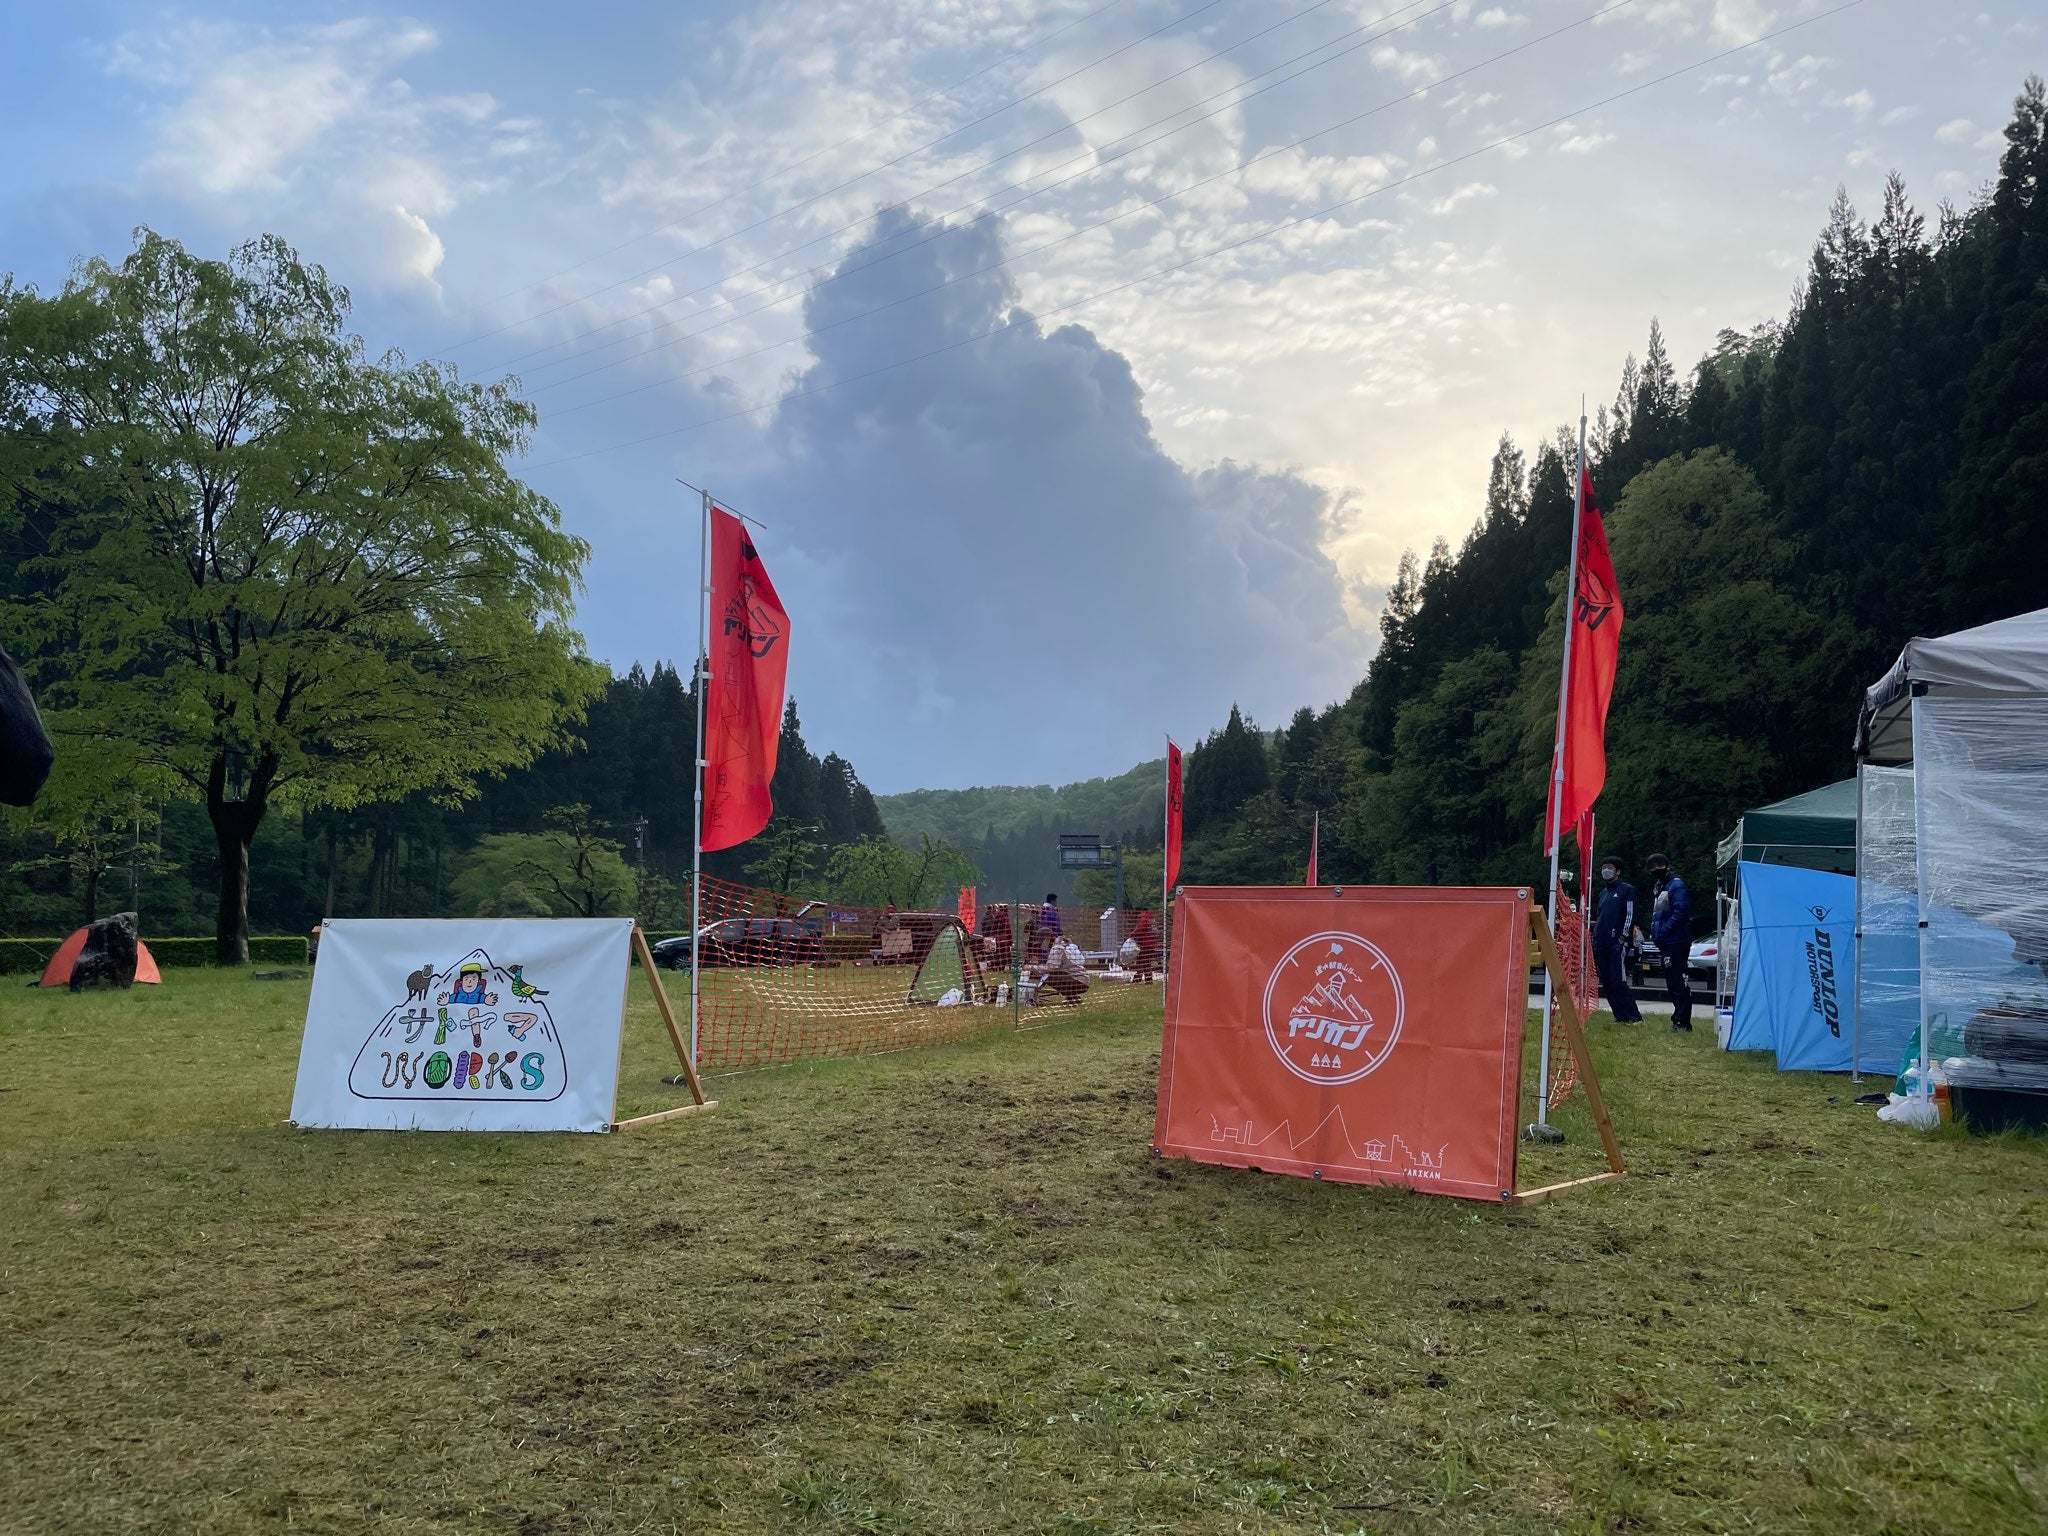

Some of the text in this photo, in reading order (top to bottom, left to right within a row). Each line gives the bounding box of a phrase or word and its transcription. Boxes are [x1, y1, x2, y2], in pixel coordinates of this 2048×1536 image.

[1805, 941, 1824, 1017] MOTORSPORT
[1814, 927, 1841, 1039] DUNLOP
[399, 1007, 538, 1048] サトヤマ
[1289, 1018, 1375, 1050] ヤリカン
[381, 1050, 545, 1090] WORKS
